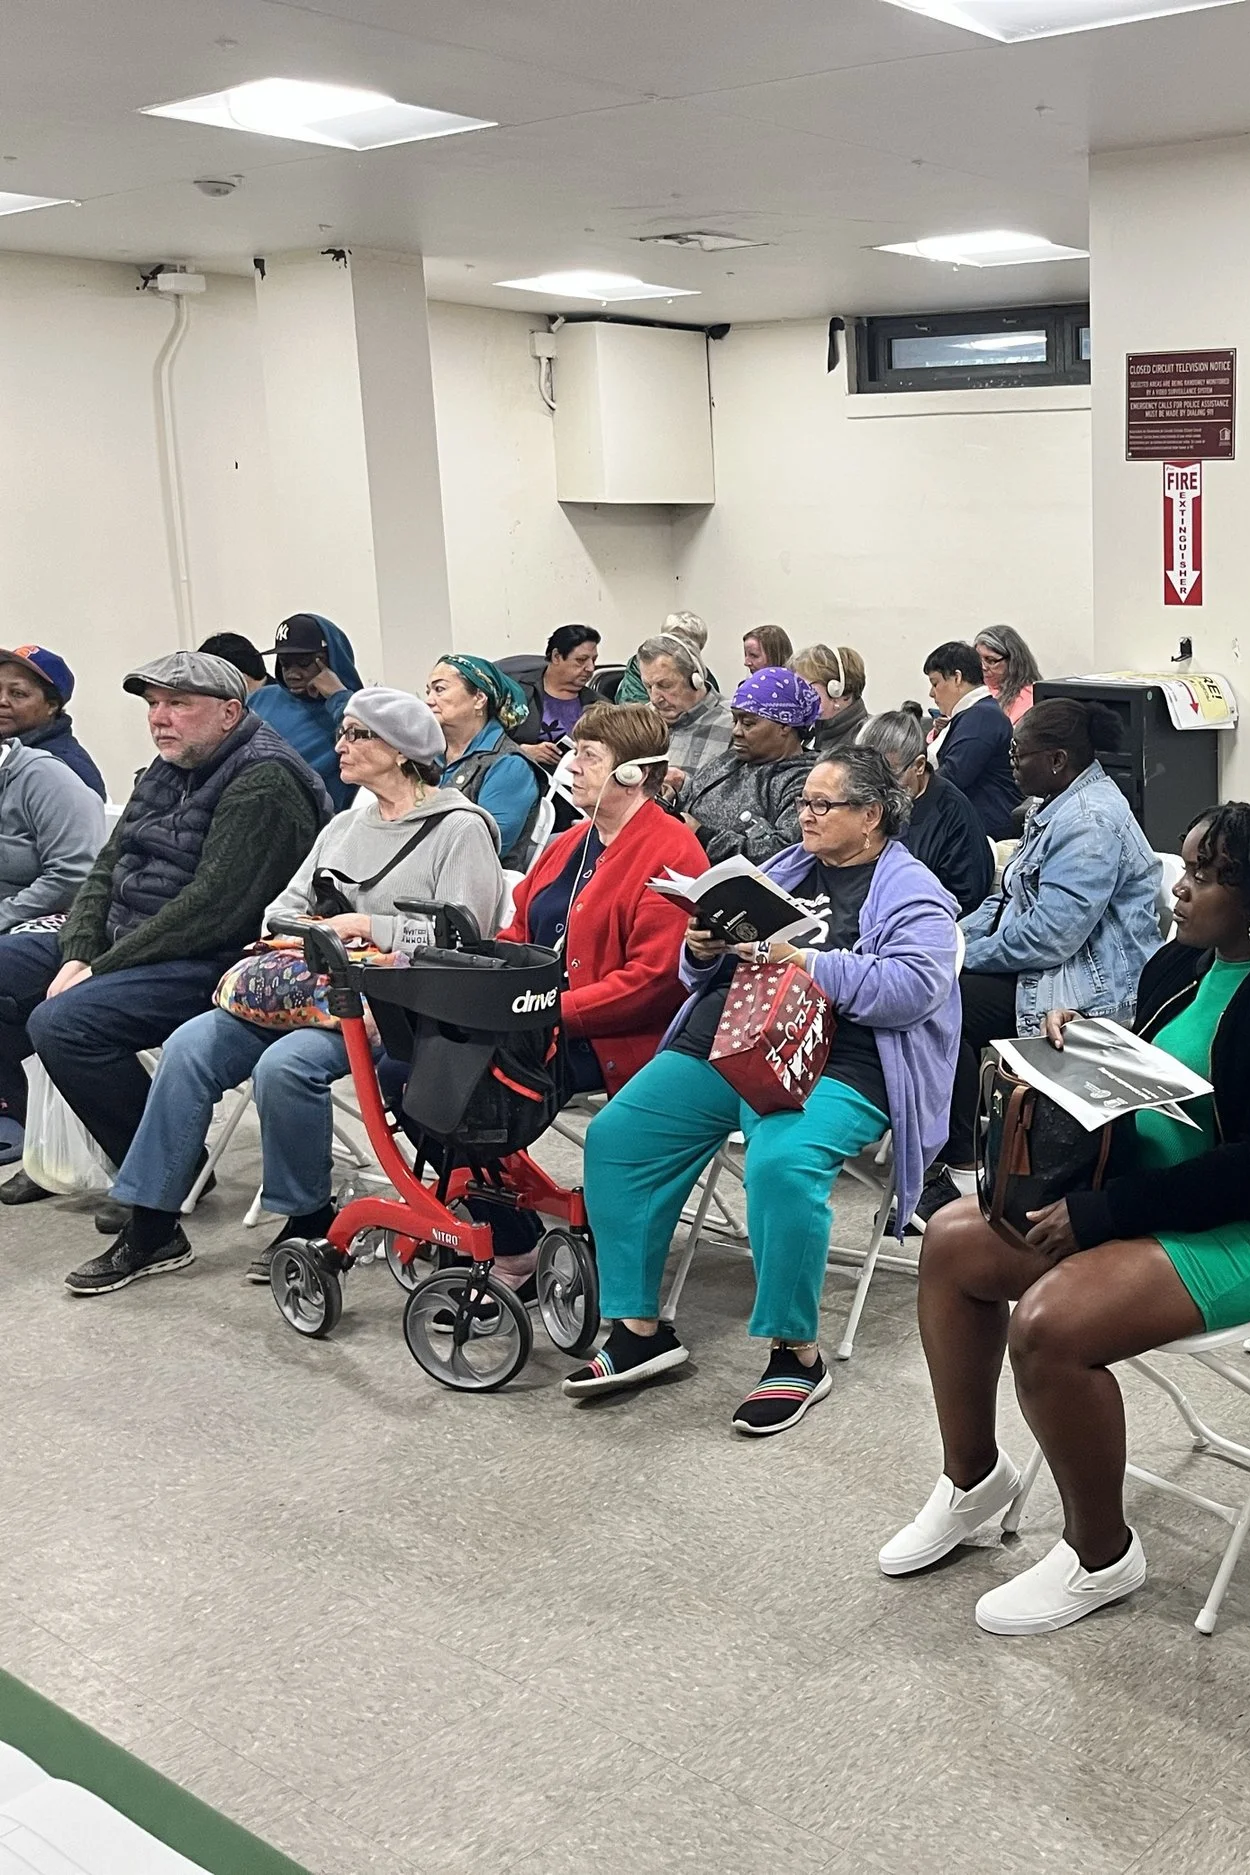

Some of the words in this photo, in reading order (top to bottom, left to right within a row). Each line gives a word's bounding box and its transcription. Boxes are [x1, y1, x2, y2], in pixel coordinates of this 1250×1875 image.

[1130, 365, 1151, 374] CLOSED
[1152, 364, 1174, 374] CIRCUIT
[1175, 362, 1209, 372] TELEVISION
[1209, 361, 1231, 371] NOTICE
[1130, 402, 1157, 410] EMERGENCY
[1158, 401, 1172, 409] CALLS
[1173, 401, 1182, 409] FOR
[1184, 400, 1200, 408] POLICE
[1201, 400, 1229, 408] ASSISTANCE
[1166, 409, 1178, 417] MADE
[1180, 409, 1186, 417] BY
[1168, 472, 1197, 490] FIRE
[1179, 491, 1187, 594] EXTINGUISHER
[512, 988, 557, 1013] drive
[432, 1228, 458, 1246] NITRO
